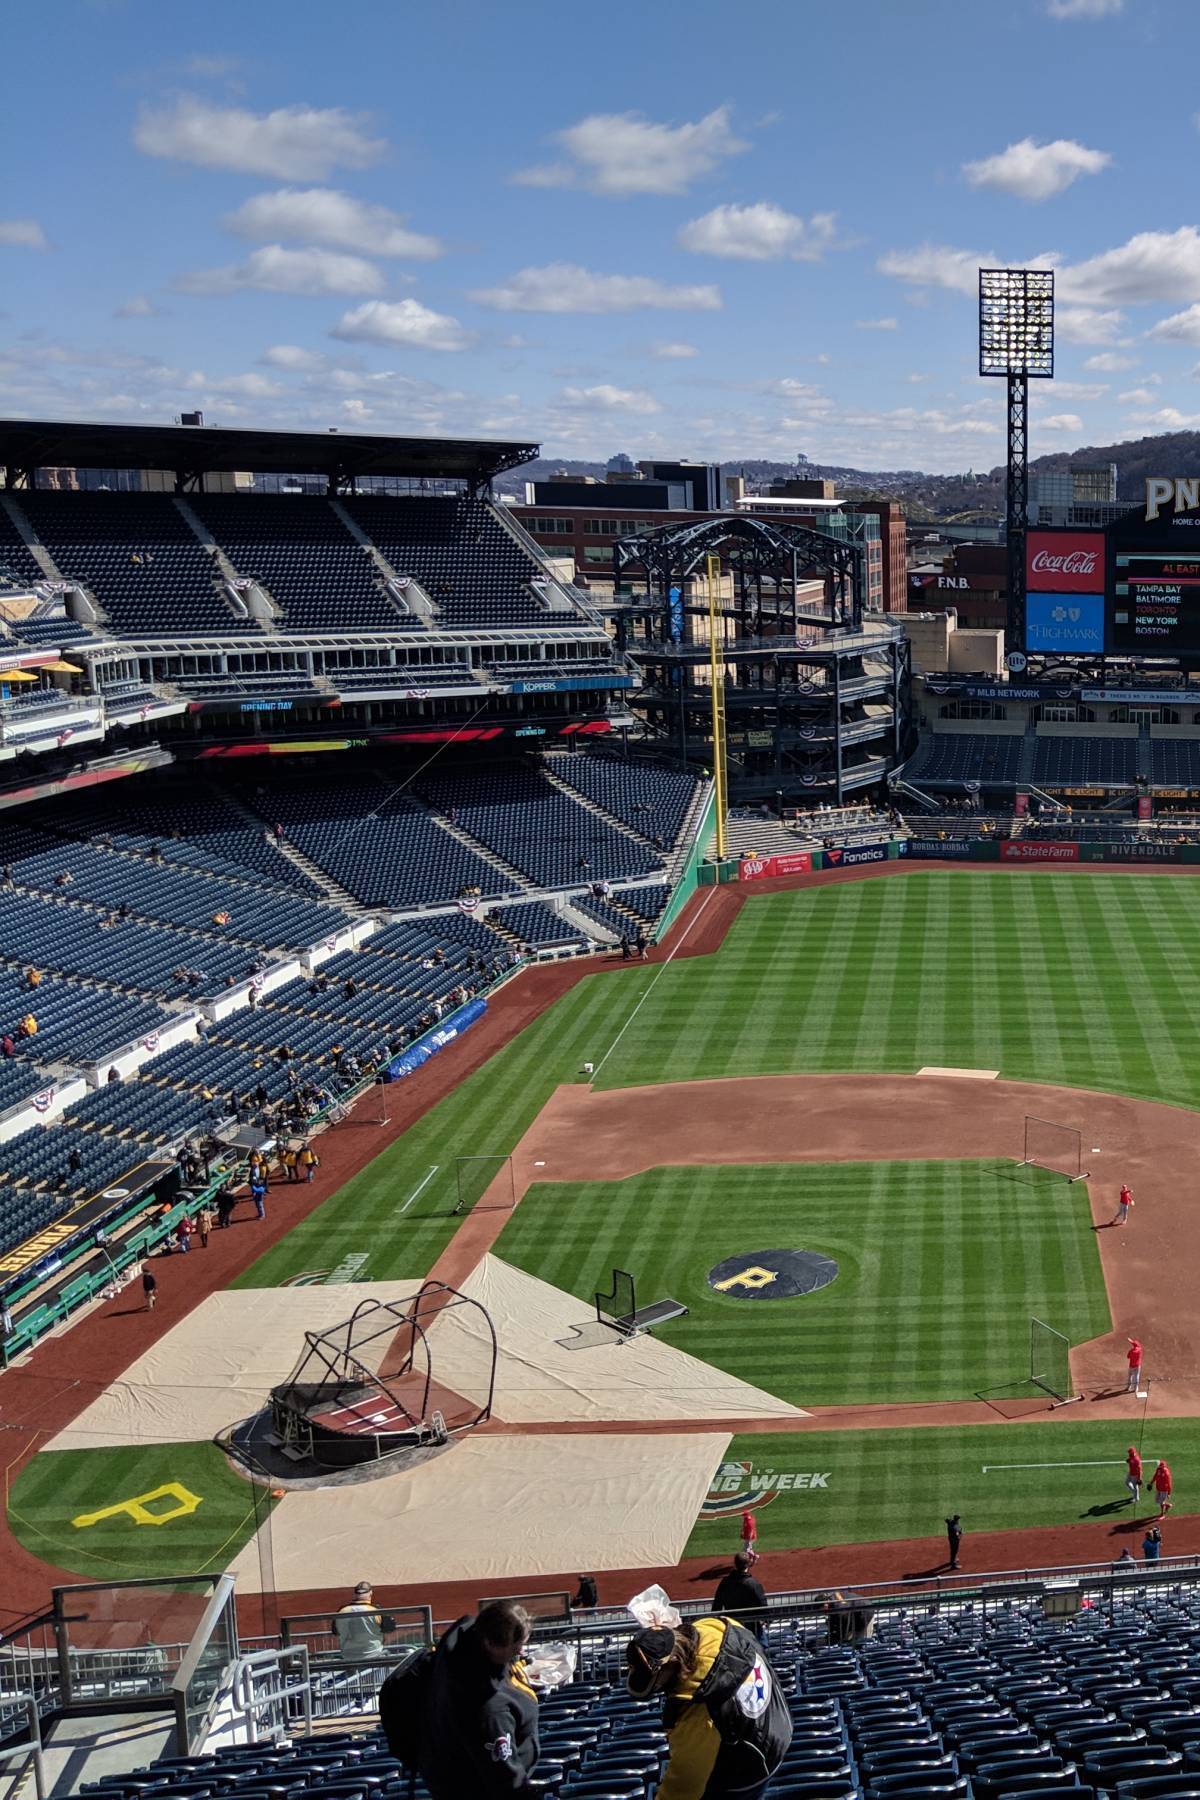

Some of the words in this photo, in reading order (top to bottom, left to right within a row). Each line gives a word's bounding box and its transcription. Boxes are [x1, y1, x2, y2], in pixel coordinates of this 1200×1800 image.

[1172, 518, 1193, 526] HOME
[1032, 550, 1099, 573] Coca-Cola
[938, 577, 971, 588] F.N.B.
[1136, 585, 1164, 593] TAMPA
[1166, 585, 1182, 593] BAY
[1136, 596, 1182, 604] BALTIMORE
[1136, 617, 1156, 625] NEW
[1157, 617, 1178, 625] YORK
[1136, 627, 1169, 635] BOSTON
[523, 682, 557, 692] KOPPERS
[977, 689, 995, 697] MLB
[997, 689, 1040, 698] NETWORK
[241, 702, 276, 712] OPENING
[277, 701, 293, 710] DAY
[1111, 845, 1176, 856] RIVENDALE
[843, 849, 884, 864] Fanatics
[0, 1224, 79, 1271] PIRATES
[713, 1266, 780, 1292] P
[750, 1472, 832, 1491] WEEK
[70, 1481, 204, 1529] P
